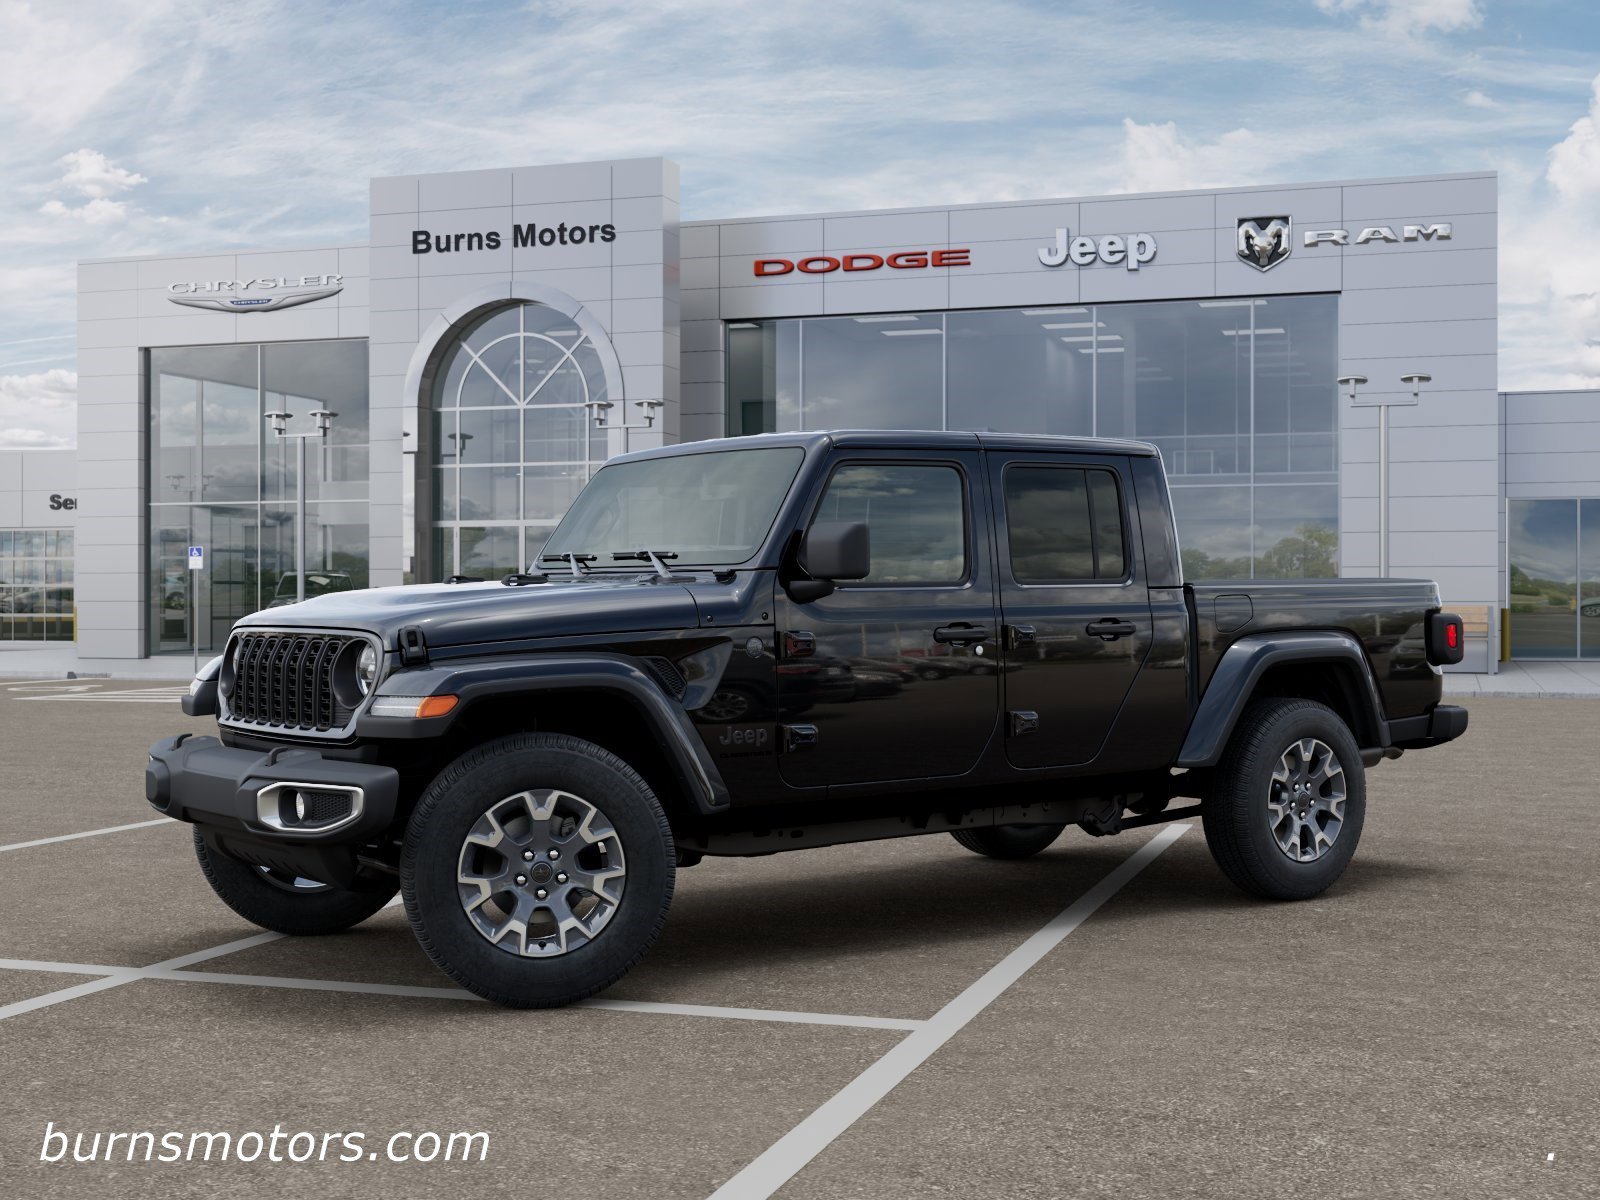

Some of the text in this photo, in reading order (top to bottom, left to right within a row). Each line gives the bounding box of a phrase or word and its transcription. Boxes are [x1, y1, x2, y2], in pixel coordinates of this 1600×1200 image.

[412, 222, 616, 254] Burns Motors
[1304, 223, 1452, 247] RAM
[1038, 227, 1157, 271] Jeep
[754, 249, 971, 275] DODGE
[168, 274, 343, 293] CHRYSLER
[49, 494, 77, 510] Se
[720, 726, 768, 746] Jeep
